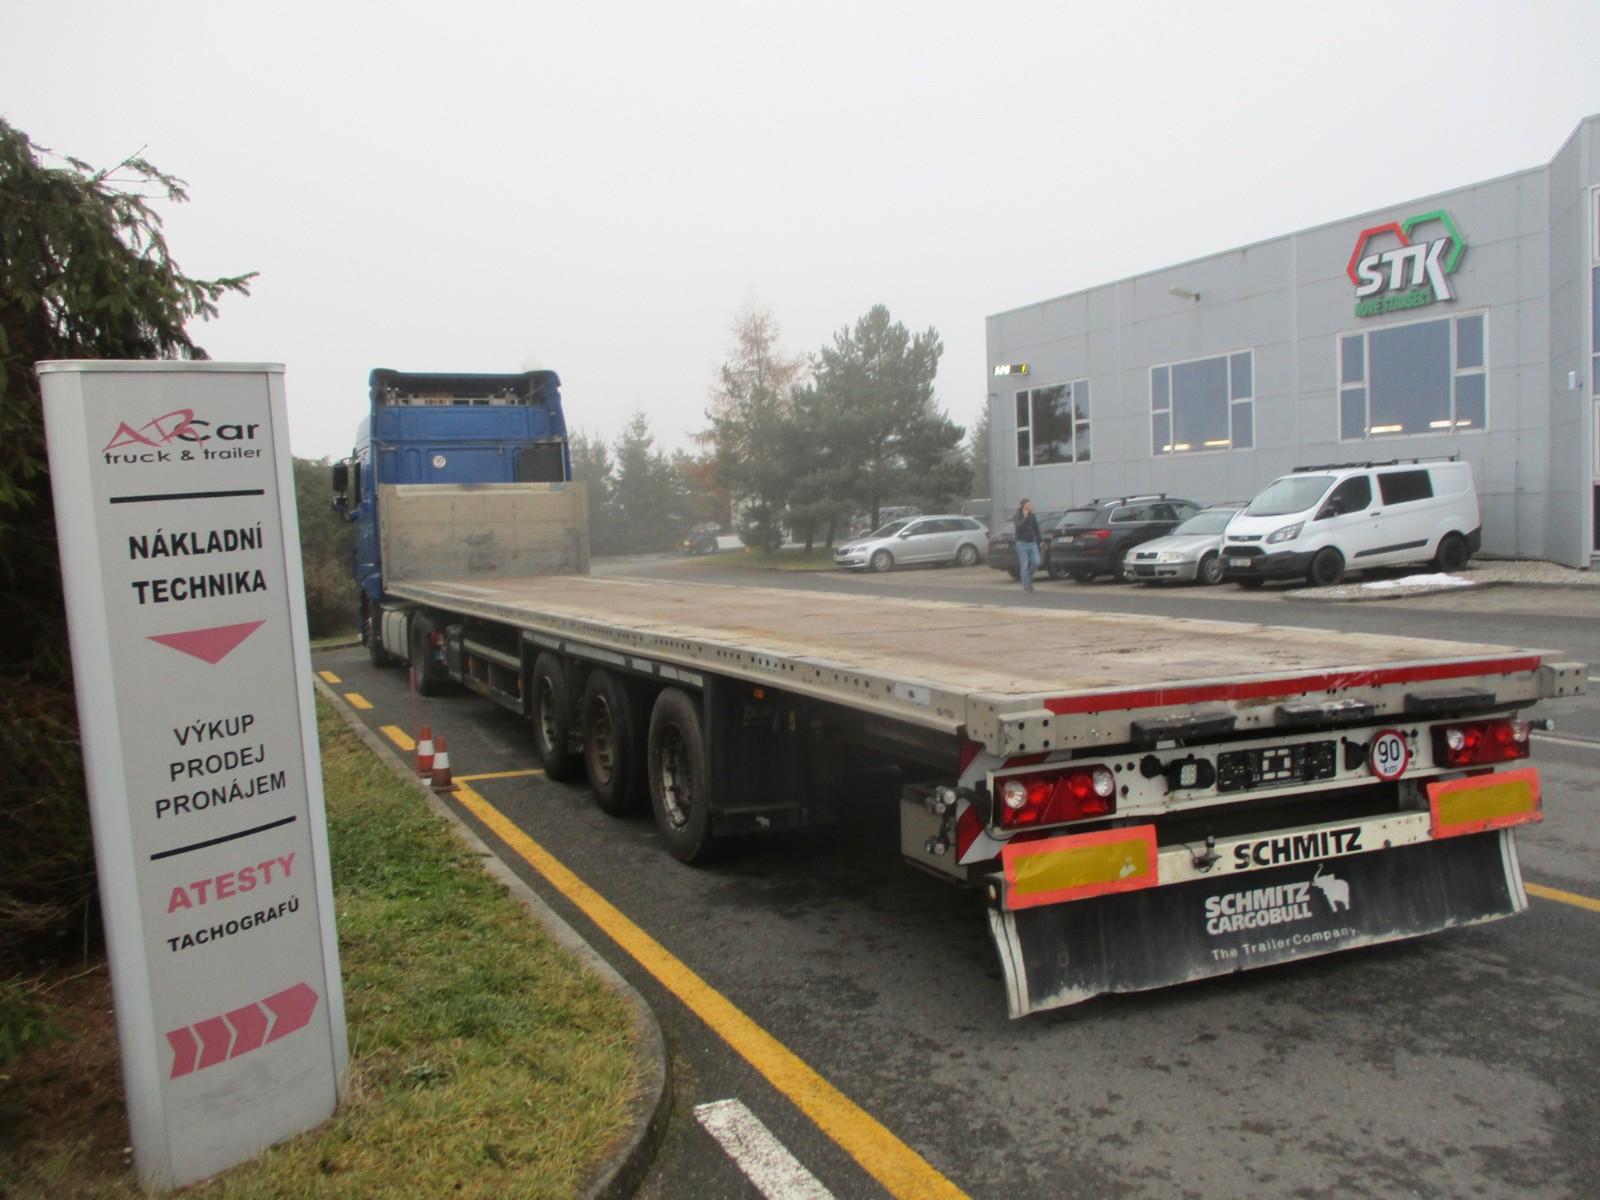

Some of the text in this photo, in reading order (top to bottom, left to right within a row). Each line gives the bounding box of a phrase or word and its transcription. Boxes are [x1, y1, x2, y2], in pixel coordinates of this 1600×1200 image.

[1356, 237, 1452, 301] STK
[104, 446, 262, 464] truck & trailer
[129, 521, 263, 559] NÁKLADNÍ
[132, 569, 267, 604] TECHNIKA
[173, 714, 255, 746] VÝKUP
[170, 744, 265, 782] PRODEJ
[1377, 738, 1400, 763] 90
[156, 770, 287, 819] PRONÁJEM
[1234, 826, 1362, 869] SCHMITZ
[167, 852, 296, 913] ATESTY
[1205, 881, 1311, 918] SCHMITZ
[1206, 902, 1313, 935] CARGOBULL
[1211, 944, 1238, 961] The
